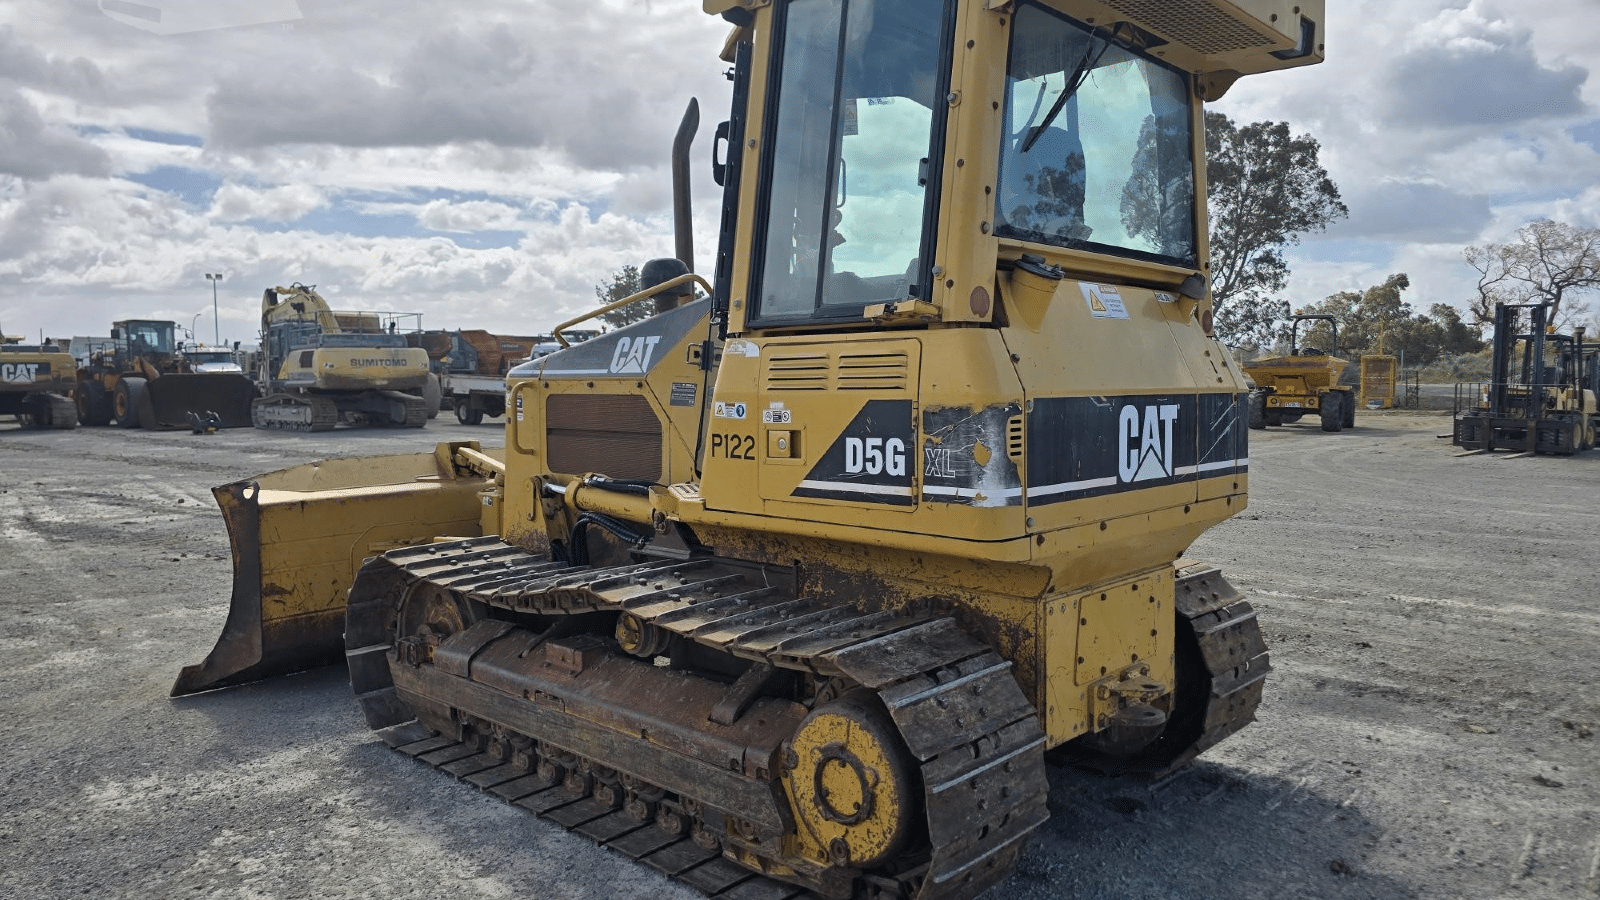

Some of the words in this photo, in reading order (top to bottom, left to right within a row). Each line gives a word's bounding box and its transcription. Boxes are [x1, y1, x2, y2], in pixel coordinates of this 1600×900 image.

[350, 358, 408, 367] SUMITOMO
[610, 336, 660, 374] CAT
[1, 363, 39, 384] CAT
[711, 433, 756, 460] P122
[845, 437, 906, 476] D5G
[924, 447, 956, 478] XL
[1118, 404, 1178, 483] CAT
